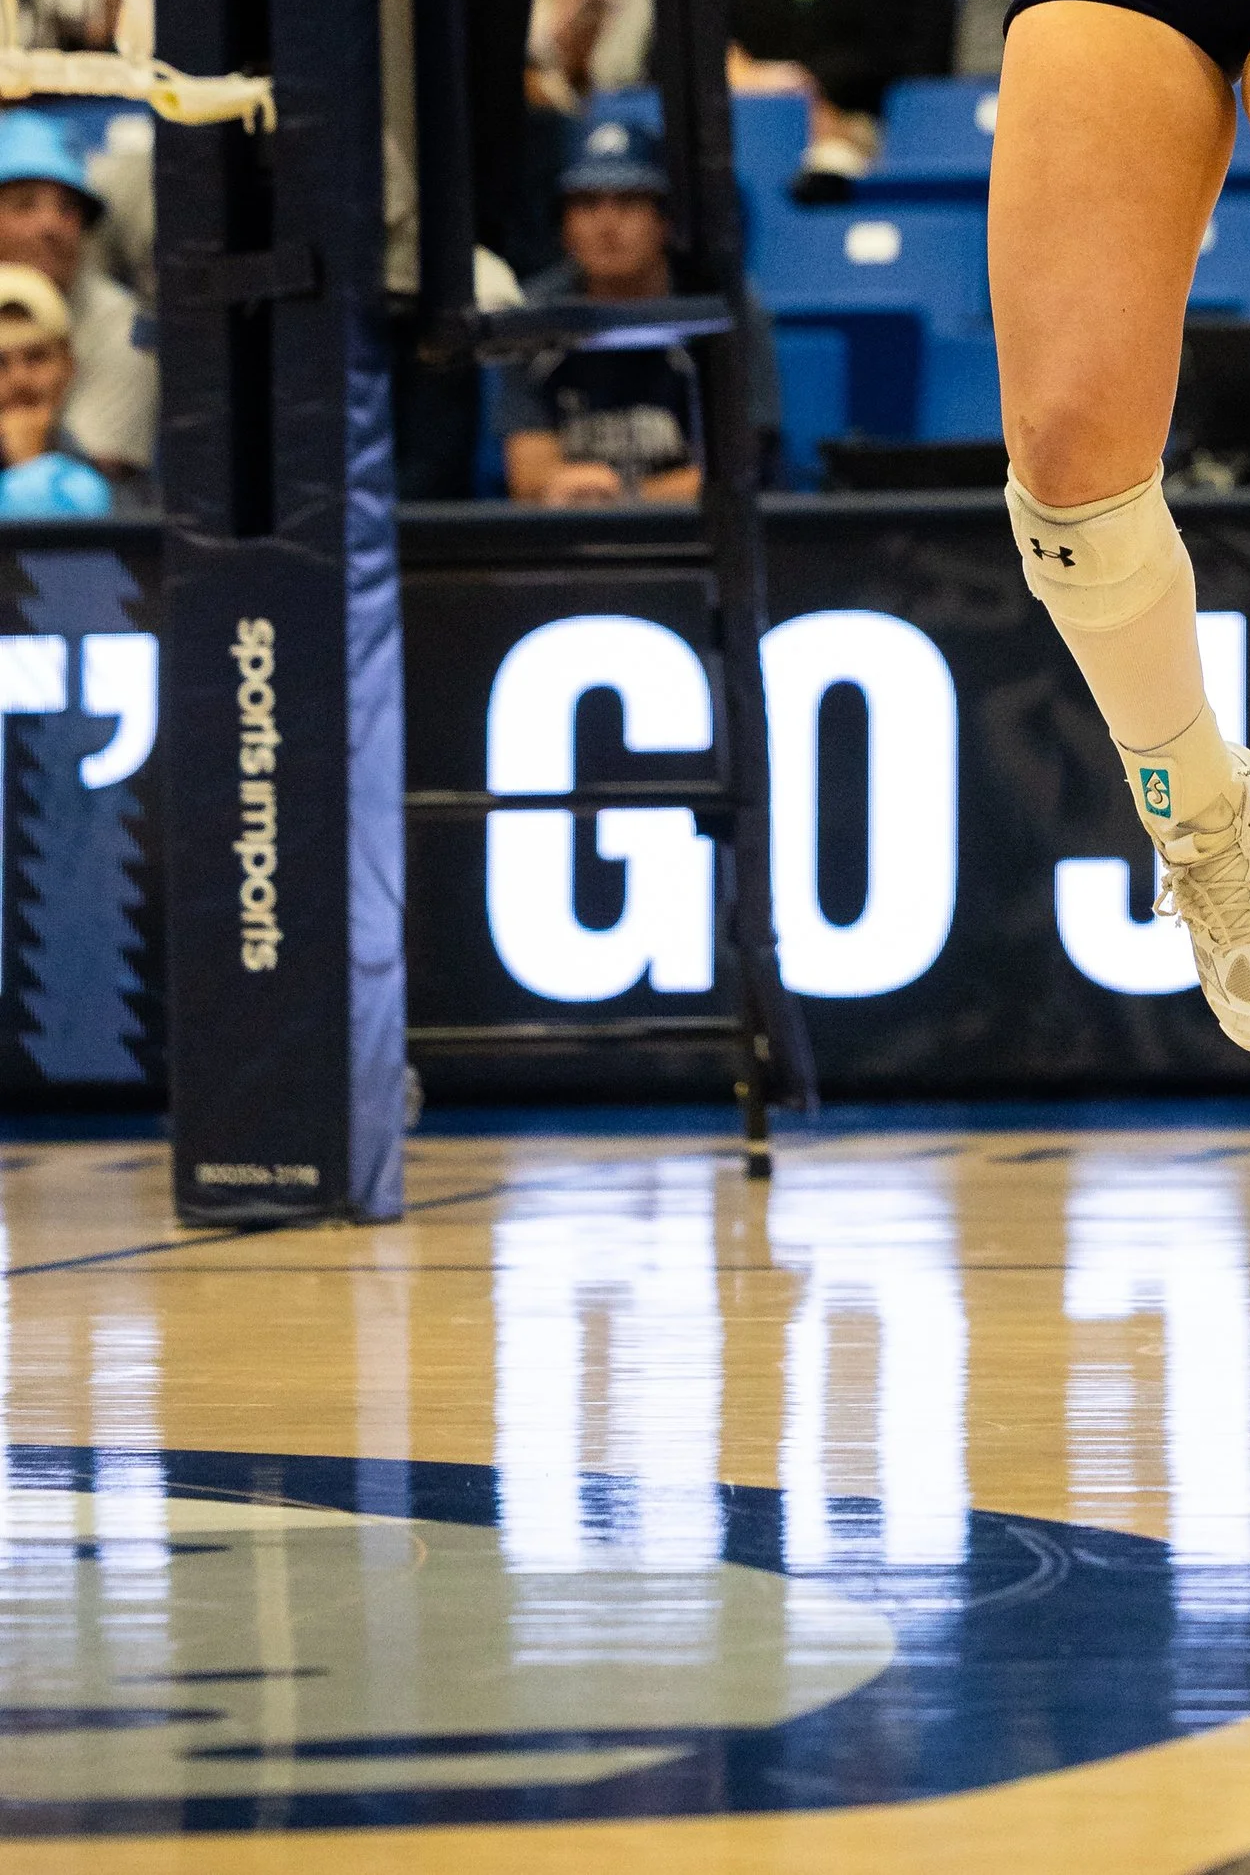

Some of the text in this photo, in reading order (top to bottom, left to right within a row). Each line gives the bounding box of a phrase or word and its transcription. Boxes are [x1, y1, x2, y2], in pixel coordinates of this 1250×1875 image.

[229, 616, 285, 972] sports imports
[487, 610, 958, 1001] GO
